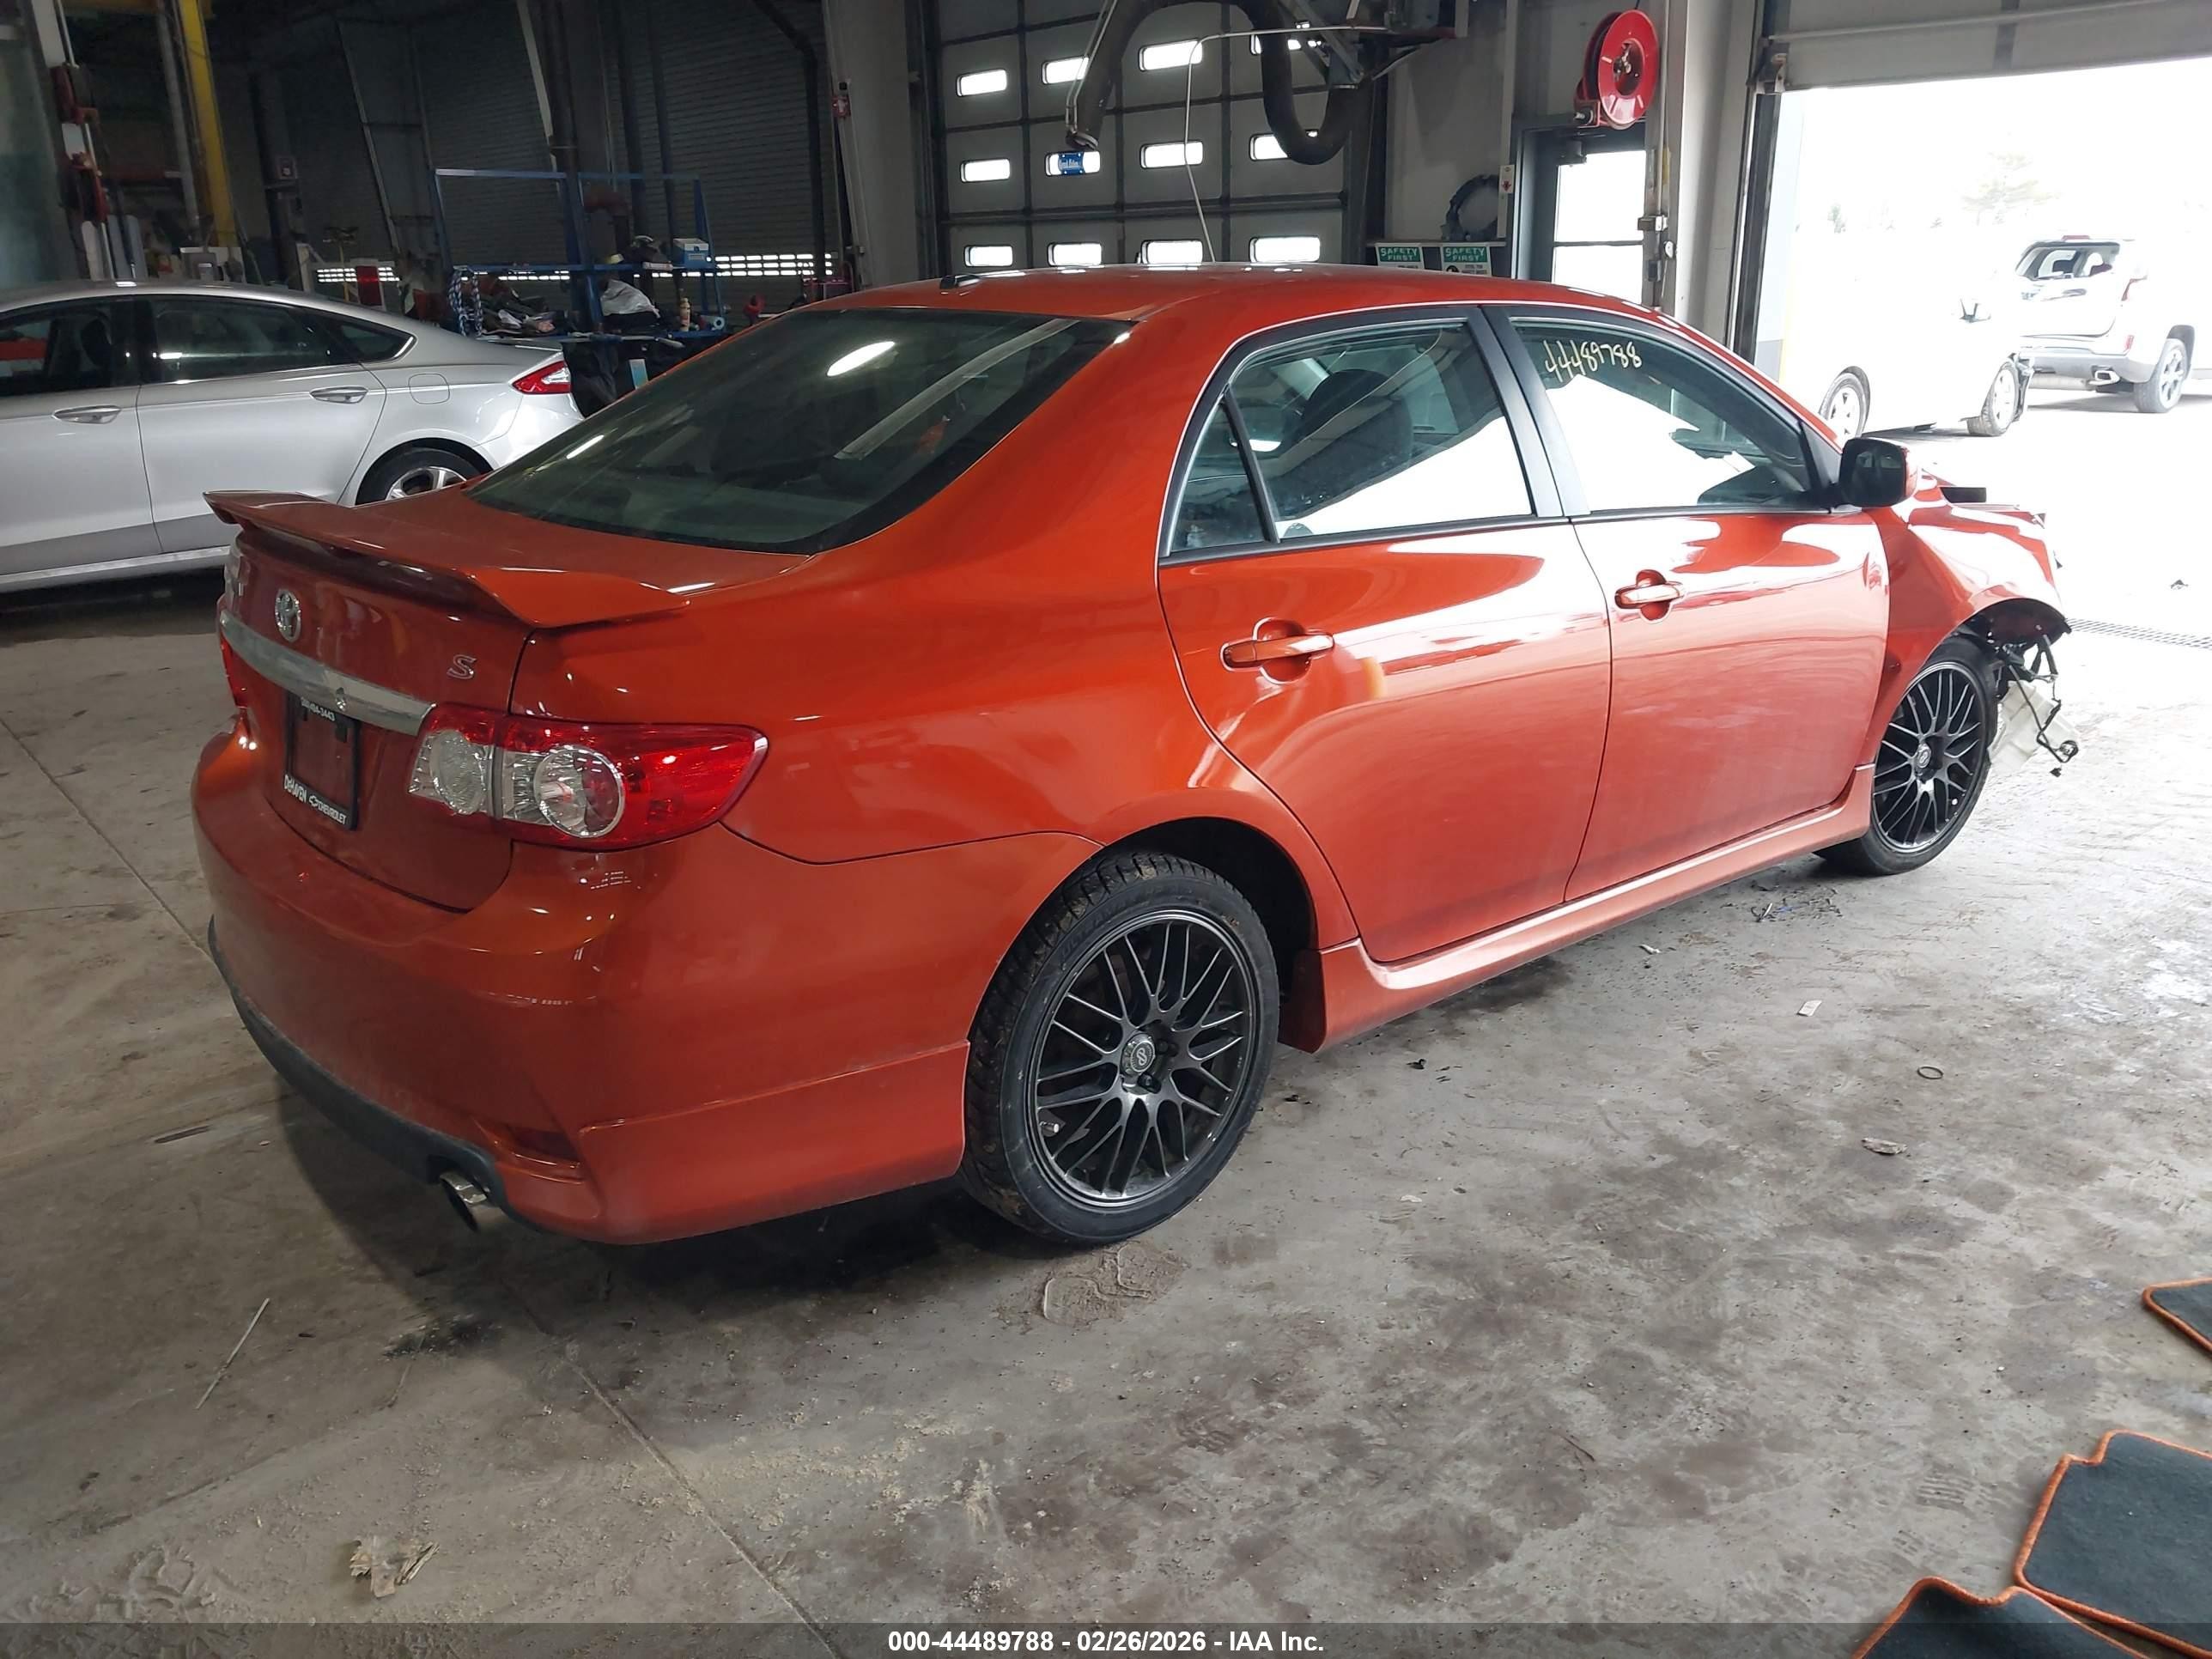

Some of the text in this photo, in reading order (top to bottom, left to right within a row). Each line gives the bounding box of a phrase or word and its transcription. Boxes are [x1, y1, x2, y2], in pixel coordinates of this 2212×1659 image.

[1380, 247, 1418, 258] SAFETY
[1445, 247, 1485, 258] SAFETY
[1543, 340, 1642, 382] 44489788
[447, 654, 477, 679] S
[318, 799, 347, 824] CHEVROLET
